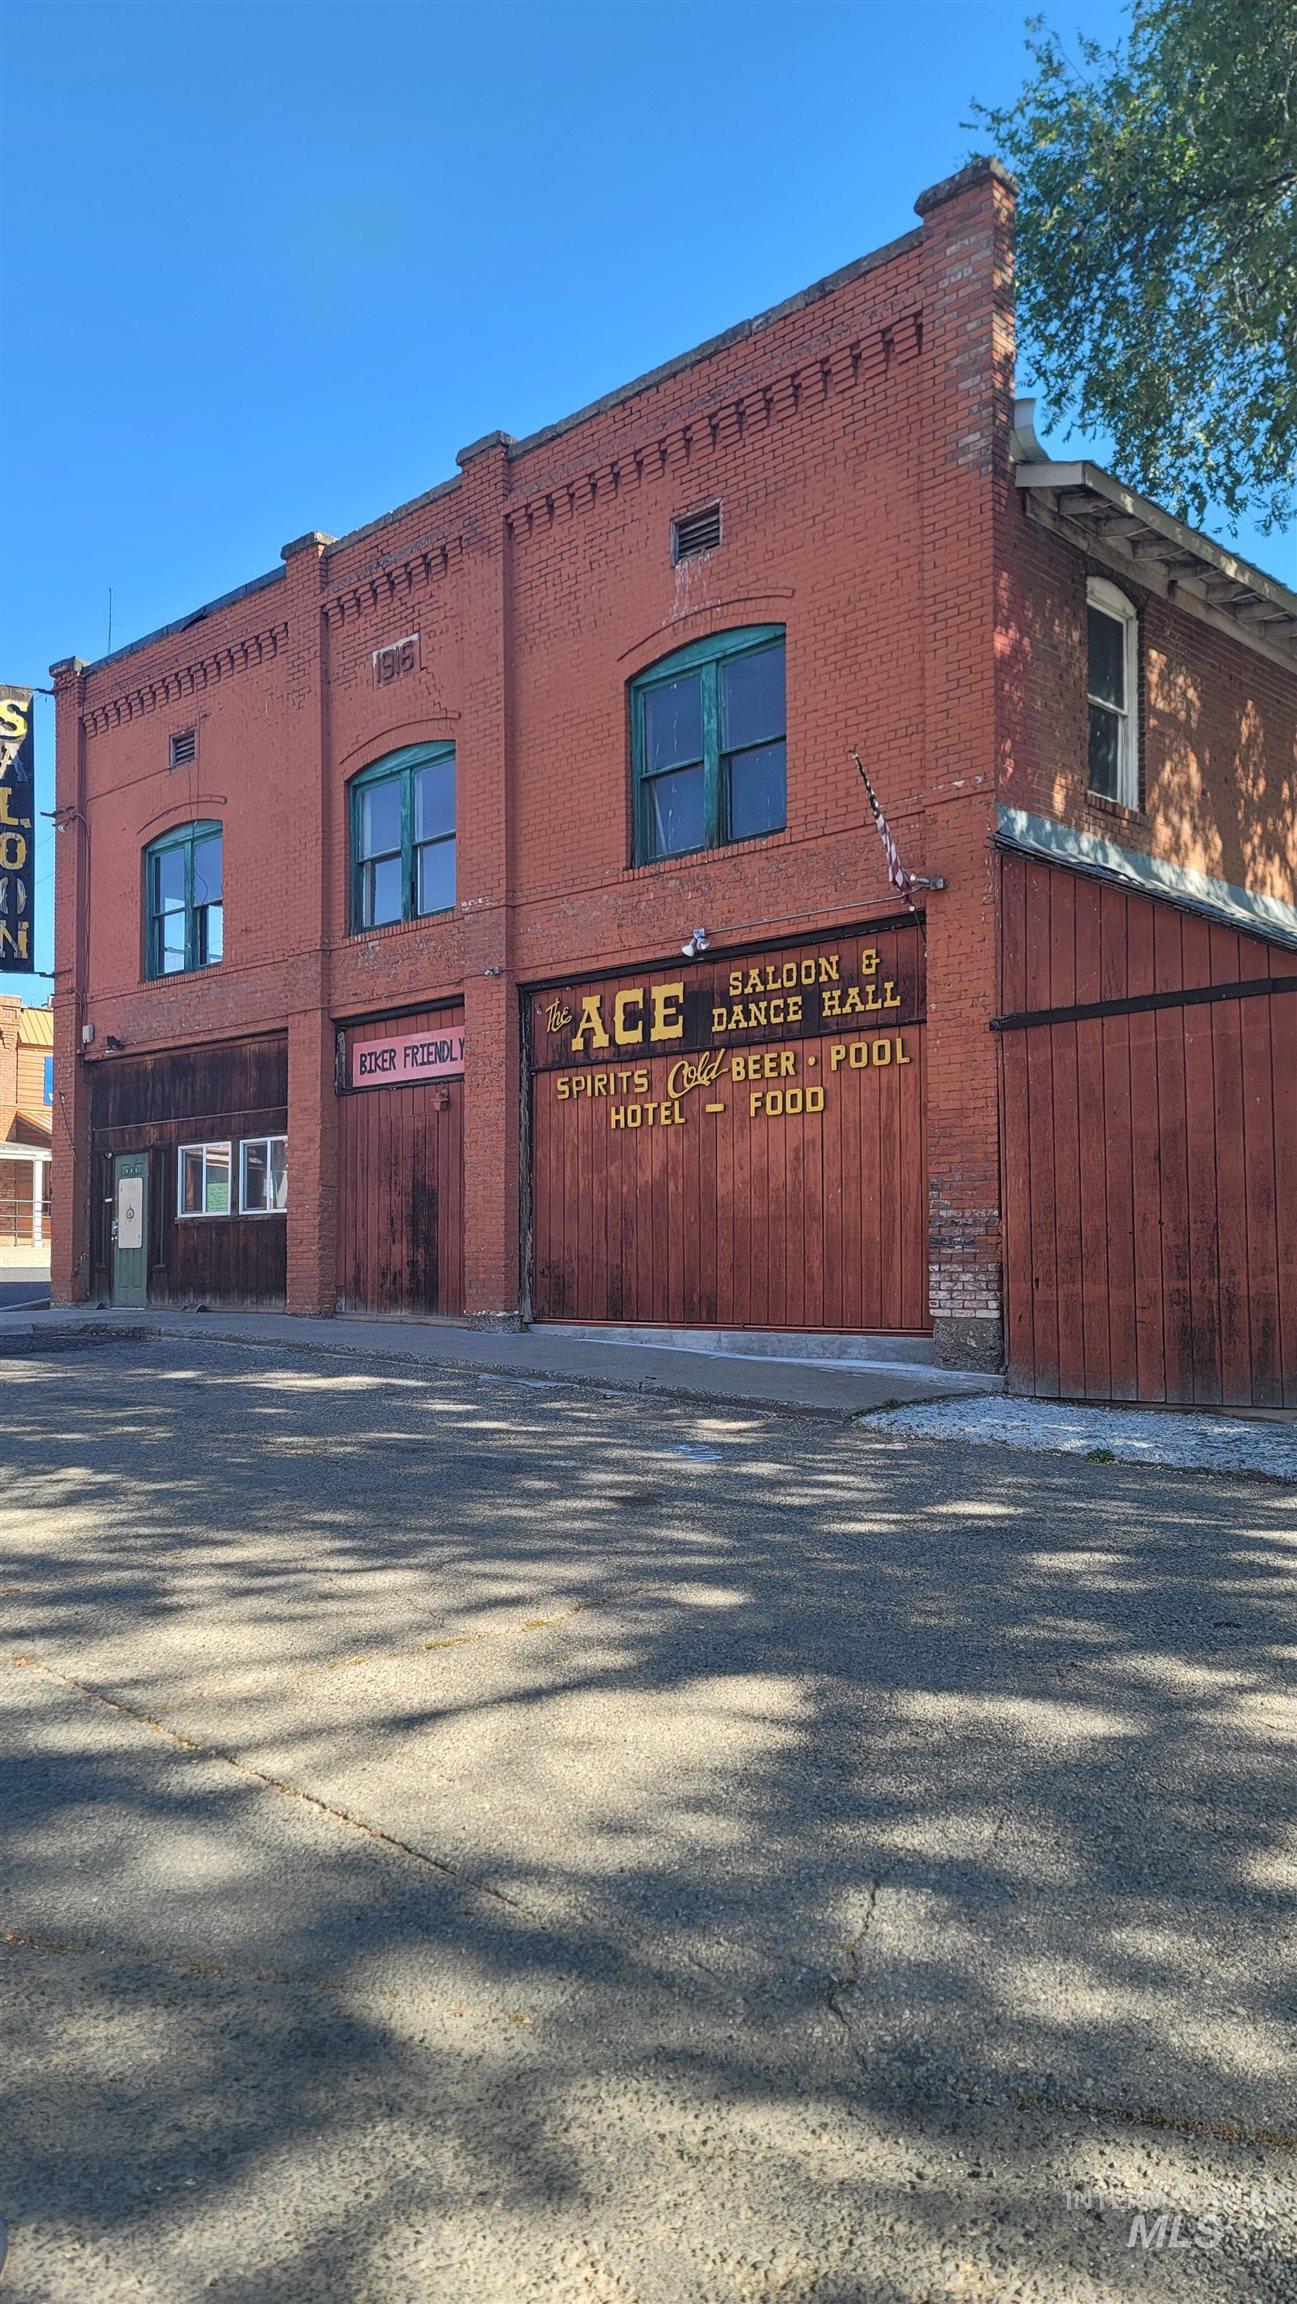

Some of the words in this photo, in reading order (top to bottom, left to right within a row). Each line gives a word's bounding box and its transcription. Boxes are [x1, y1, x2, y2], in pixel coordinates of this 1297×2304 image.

[377, 640, 415, 683] 1916
[729, 954, 840, 997] SALOON
[861, 948, 881, 976] &
[545, 997, 573, 1033] The
[571, 982, 684, 1051] ACE
[711, 996, 803, 1033] DANCE
[821, 981, 902, 1017] HALL
[359, 1048, 397, 1075] BIKER
[403, 1038, 465, 1069] FRIENDLY
[556, 1069, 649, 1100] SPIRITS
[667, 1048, 730, 1099] Cold
[731, 1051, 796, 1082] BEER
[830, 1037, 911, 1071] POOL
[610, 1100, 686, 1129] HOTEL
[750, 1086, 825, 1117] FOOD
